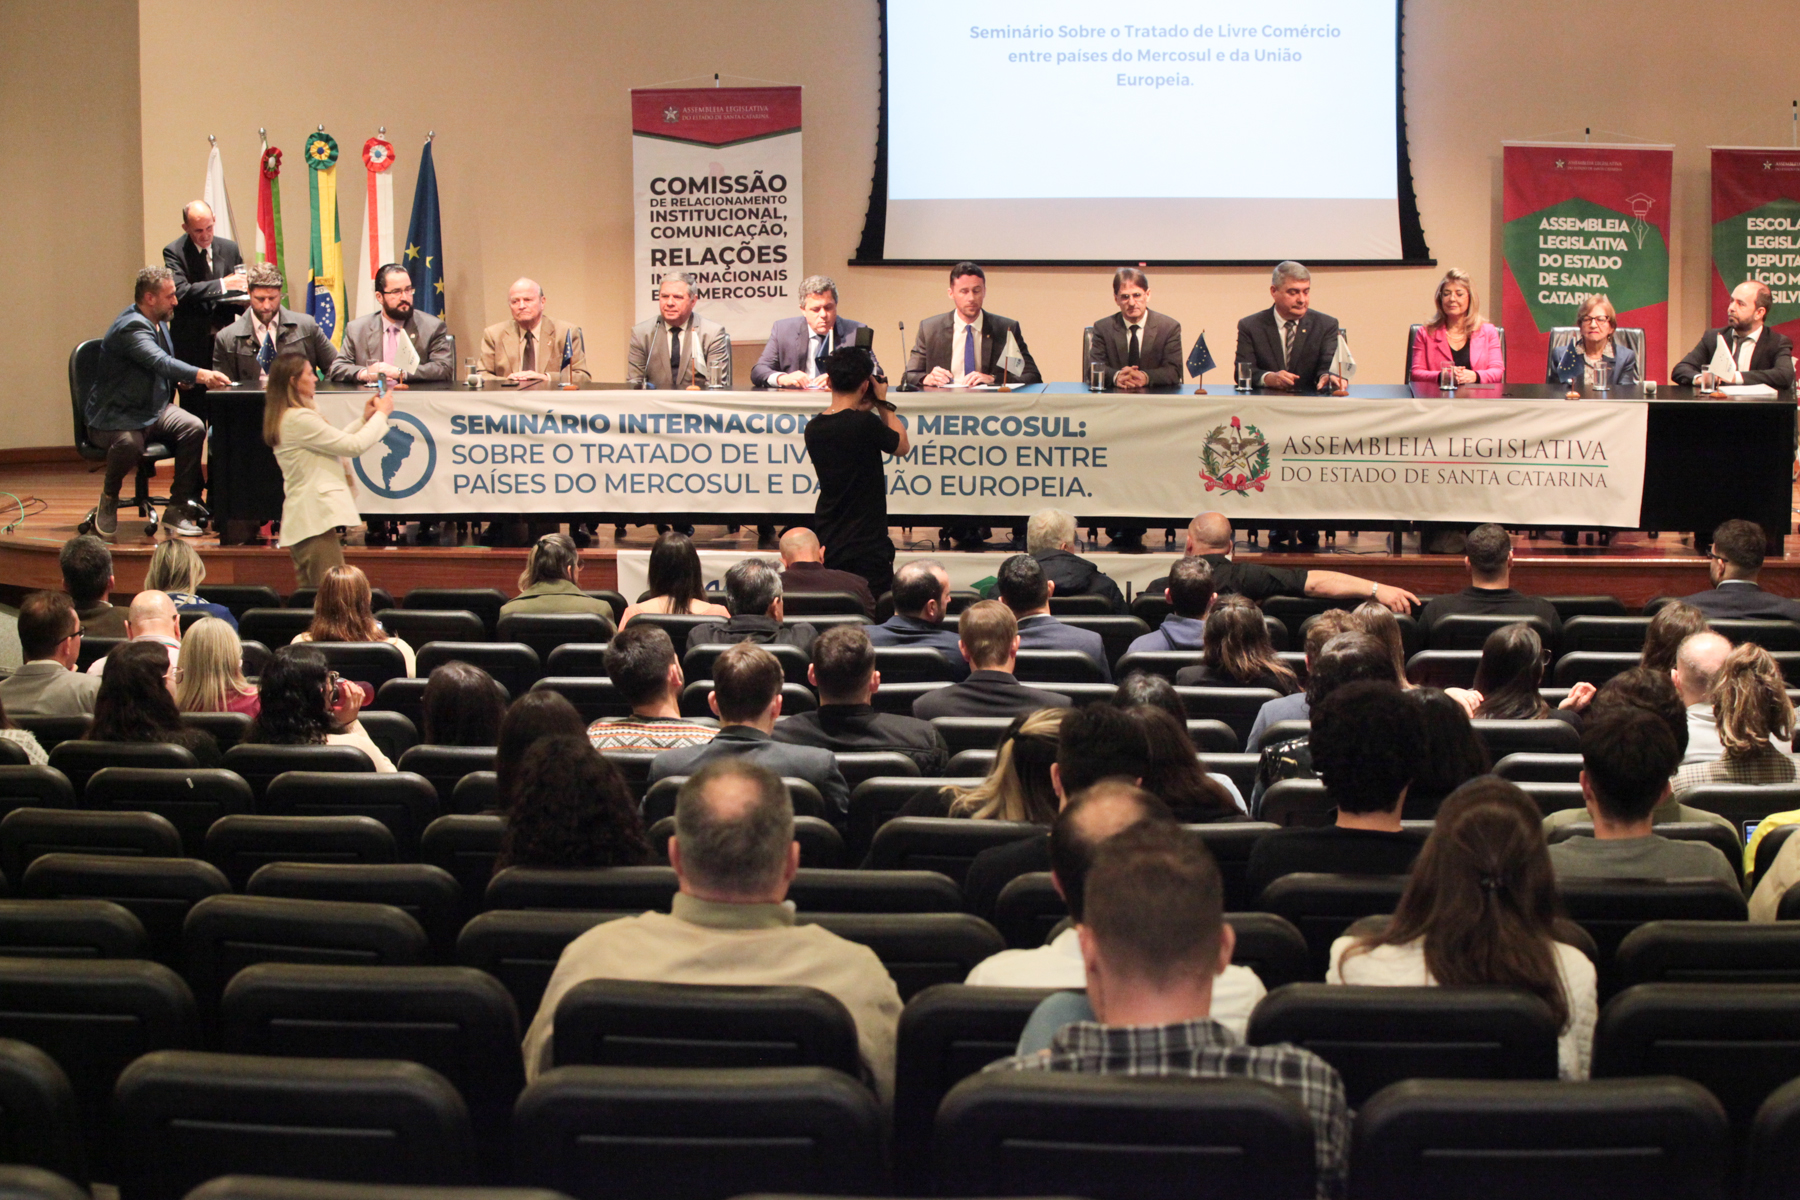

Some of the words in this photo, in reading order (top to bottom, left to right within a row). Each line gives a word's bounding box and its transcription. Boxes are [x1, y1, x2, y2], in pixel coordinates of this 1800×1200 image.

[970, 23, 1054, 39] Seminário
[1058, 24, 1106, 39] Sobre
[1110, 28, 1121, 39] o
[1124, 24, 1189, 39] Tratado
[1193, 24, 1214, 39] de
[1218, 24, 1258, 39] Livre
[1261, 23, 1341, 39] Comércio
[1007, 49, 1053, 63] entre
[1056, 48, 1108, 66] países
[1111, 48, 1133, 62] do
[1137, 48, 1211, 62] Mercosul
[1215, 52, 1226, 62] e
[1229, 48, 1250, 62] da
[1254, 47, 1303, 62] União
[1116, 72, 1194, 90] Europeia.
[650, 170, 787, 195] COMISSÃO
[650, 198, 667, 207] DE
[671, 195, 787, 207] RELACIONAMENTO
[650, 207, 788, 222] INSTITUCIONAL,
[651, 220, 788, 240] COMUNICAÇÃO,
[1539, 217, 1630, 232] ASSEMBLEIA
[1539, 235, 1628, 251] LEGISLATIVA
[651, 240, 788, 270] RELAÇÕES
[1539, 253, 1562, 267] DO
[1564, 254, 1622, 269] ESTADO
[1539, 272, 1559, 286] DE
[1560, 272, 1609, 288] SANTA
[697, 286, 788, 300] MERCOSUL
[451, 409, 610, 435] SEMINÁRIO
[918, 415, 1086, 437] MERCOSUL:
[451, 444, 544, 464] SOBRE
[553, 443, 574, 464] O
[580, 443, 712, 464] TRATADO
[721, 443, 758, 464] DE
[1017, 446, 1107, 467] ENTRE
[1282, 435, 1438, 457] ASSEMBLEIA
[1449, 437, 1606, 460] LEGISLATIVA
[454, 469, 546, 494] PAÍSES
[555, 473, 596, 494] DO
[605, 473, 760, 494] MERCOSUL
[768, 474, 783, 494] E
[941, 475, 1093, 497] EUROPEIA.
[1282, 466, 1312, 482] DO
[1320, 467, 1398, 484] ESTADO
[1405, 468, 1429, 484] DE
[1438, 469, 1501, 486] SANTA
[1507, 471, 1609, 488] CATARINA
